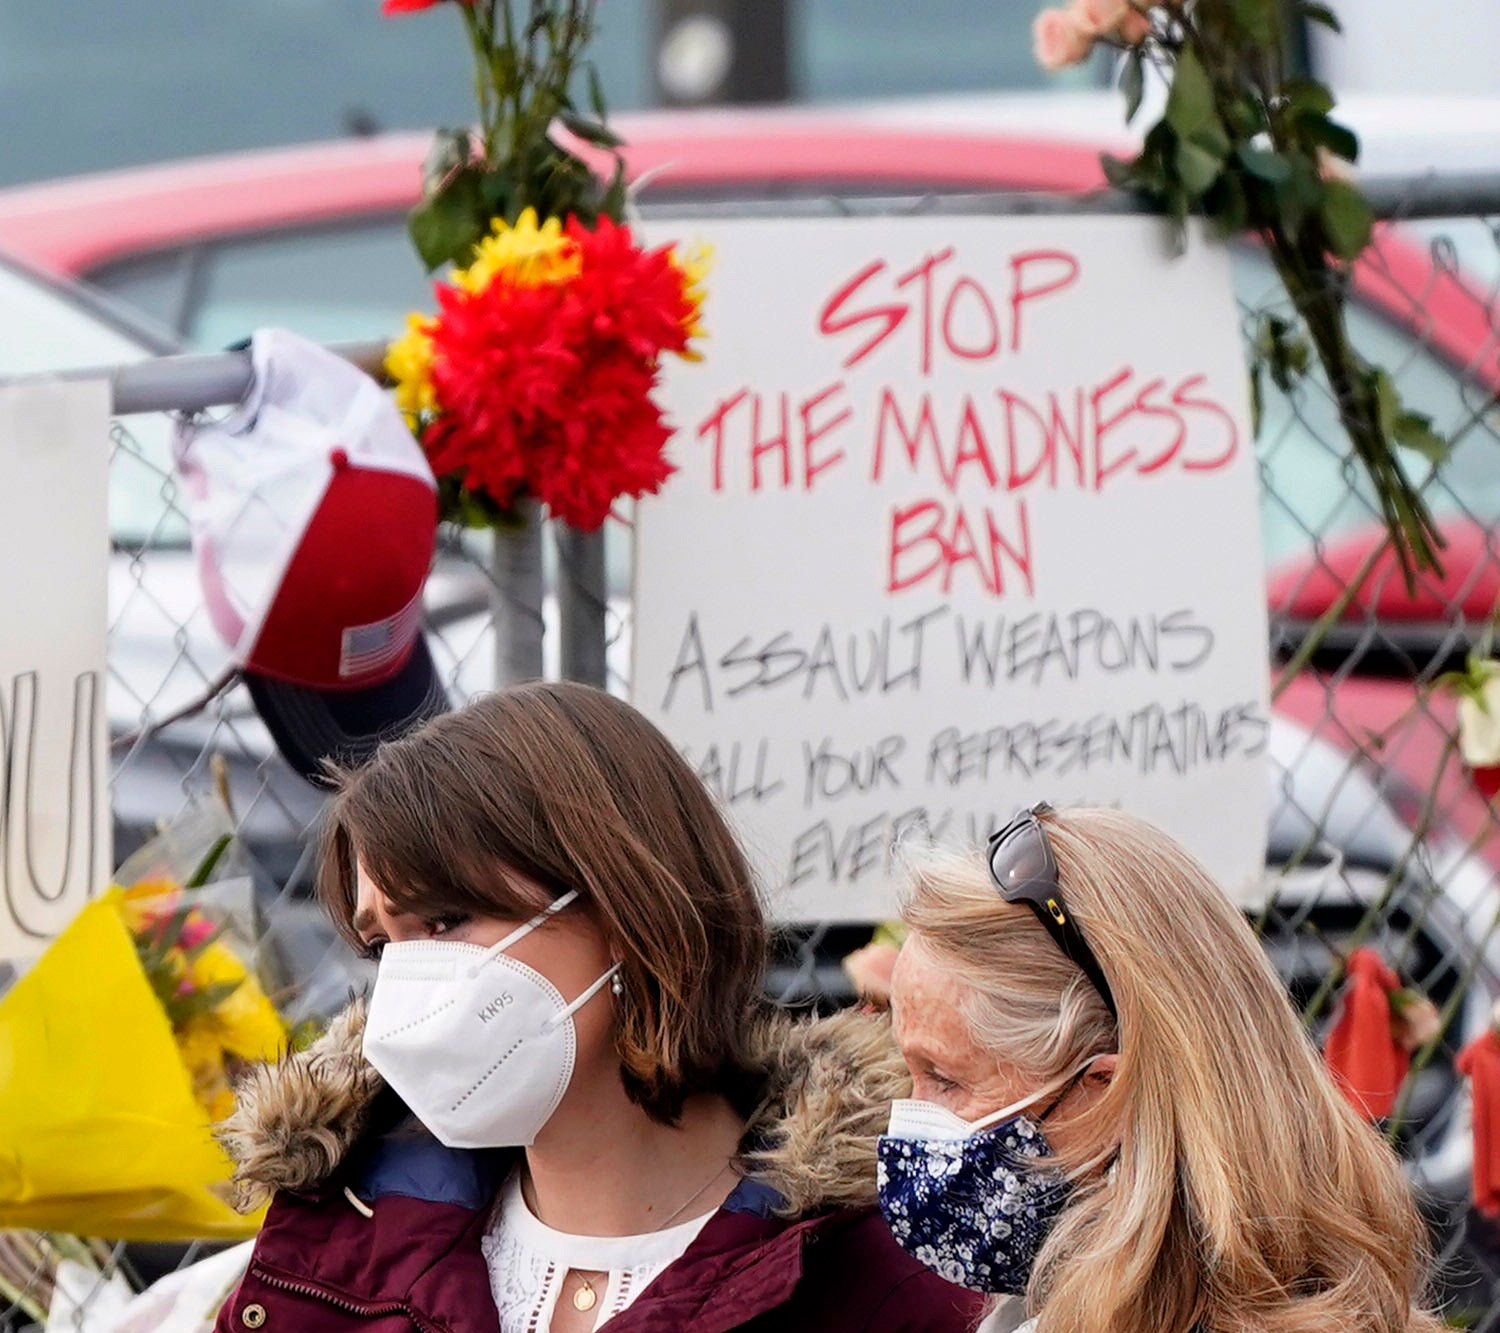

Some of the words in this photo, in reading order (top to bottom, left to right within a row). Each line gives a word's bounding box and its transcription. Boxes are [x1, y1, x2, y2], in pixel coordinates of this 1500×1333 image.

[819, 247, 1080, 374] STOP
[698, 381, 853, 491] THE
[873, 366, 1238, 491] MADNESS
[886, 498, 1034, 598] BAN
[661, 605, 950, 712] ASSAULT
[953, 608, 1214, 688] WEAPONS
[684, 736, 785, 804] ALL
[802, 734, 906, 808] YOUR
[924, 700, 1270, 785] REPRESENTATIVES
[477, 990, 514, 1023] KN95
